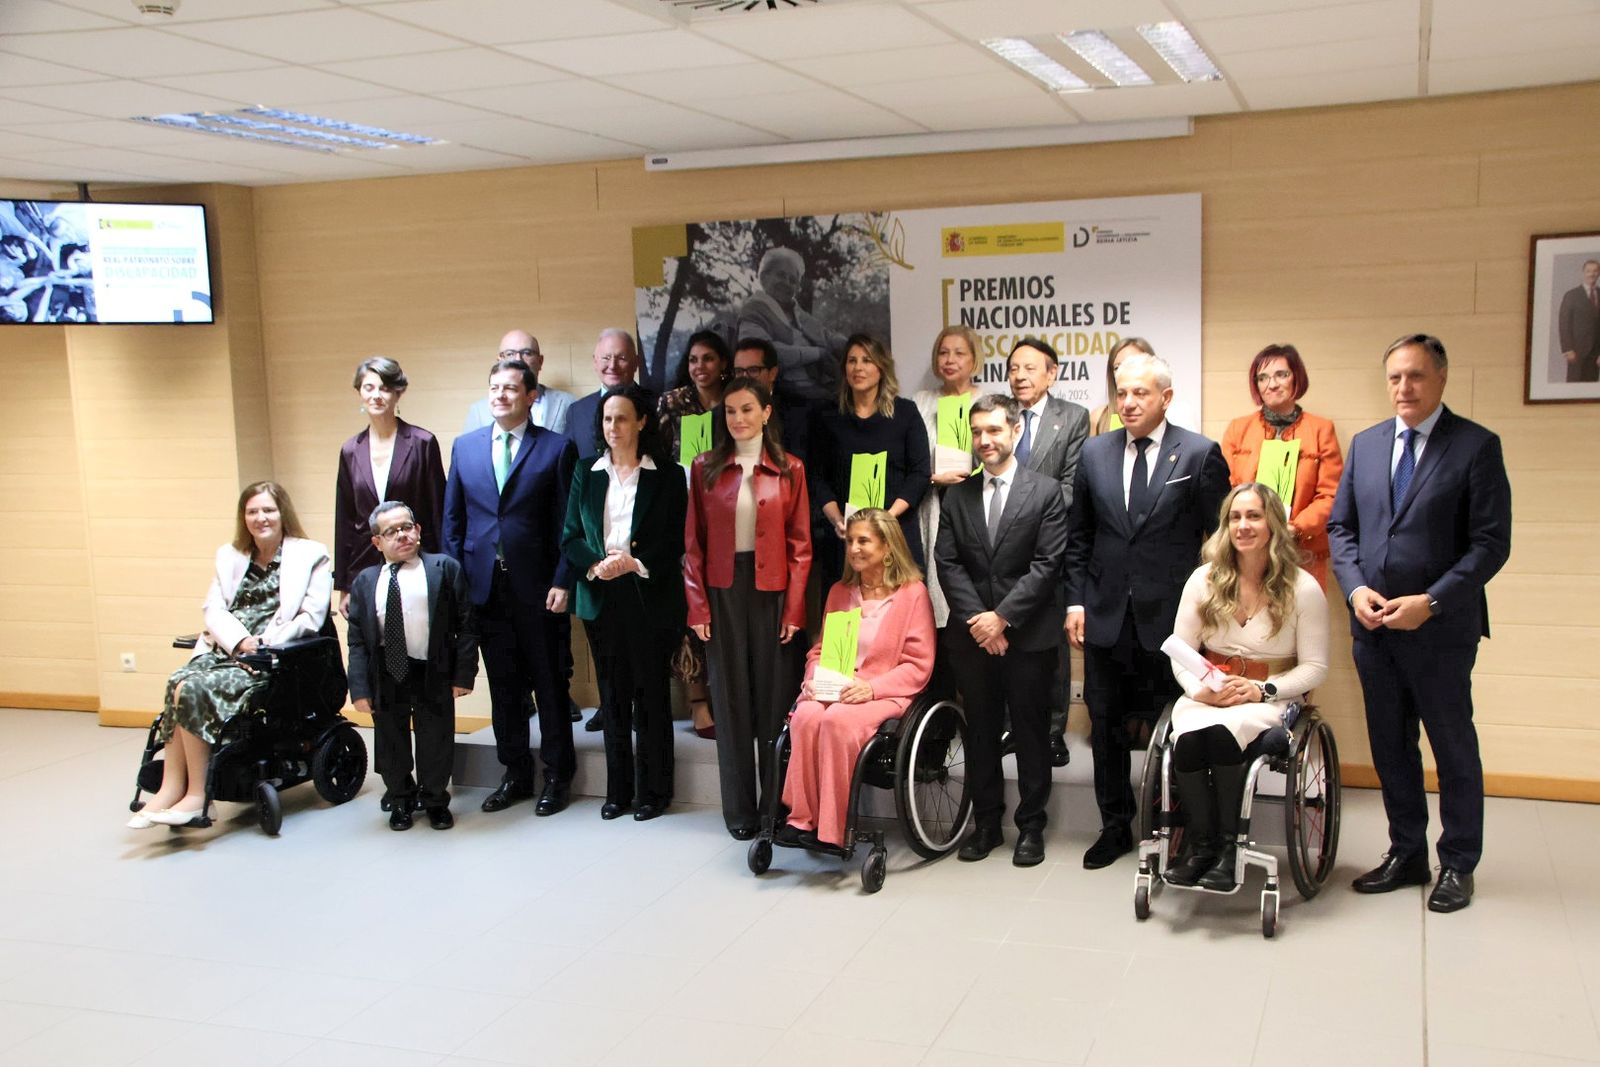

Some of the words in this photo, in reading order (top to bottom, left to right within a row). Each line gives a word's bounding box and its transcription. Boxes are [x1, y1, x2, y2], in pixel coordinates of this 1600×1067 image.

[123, 256, 169, 264] PATRONATO
[104, 266, 198, 279] DISCAPACIDAD
[960, 275, 1055, 302] PREMIOS
[960, 302, 1095, 330] NACIONALES
[1103, 301, 1131, 326] DE
